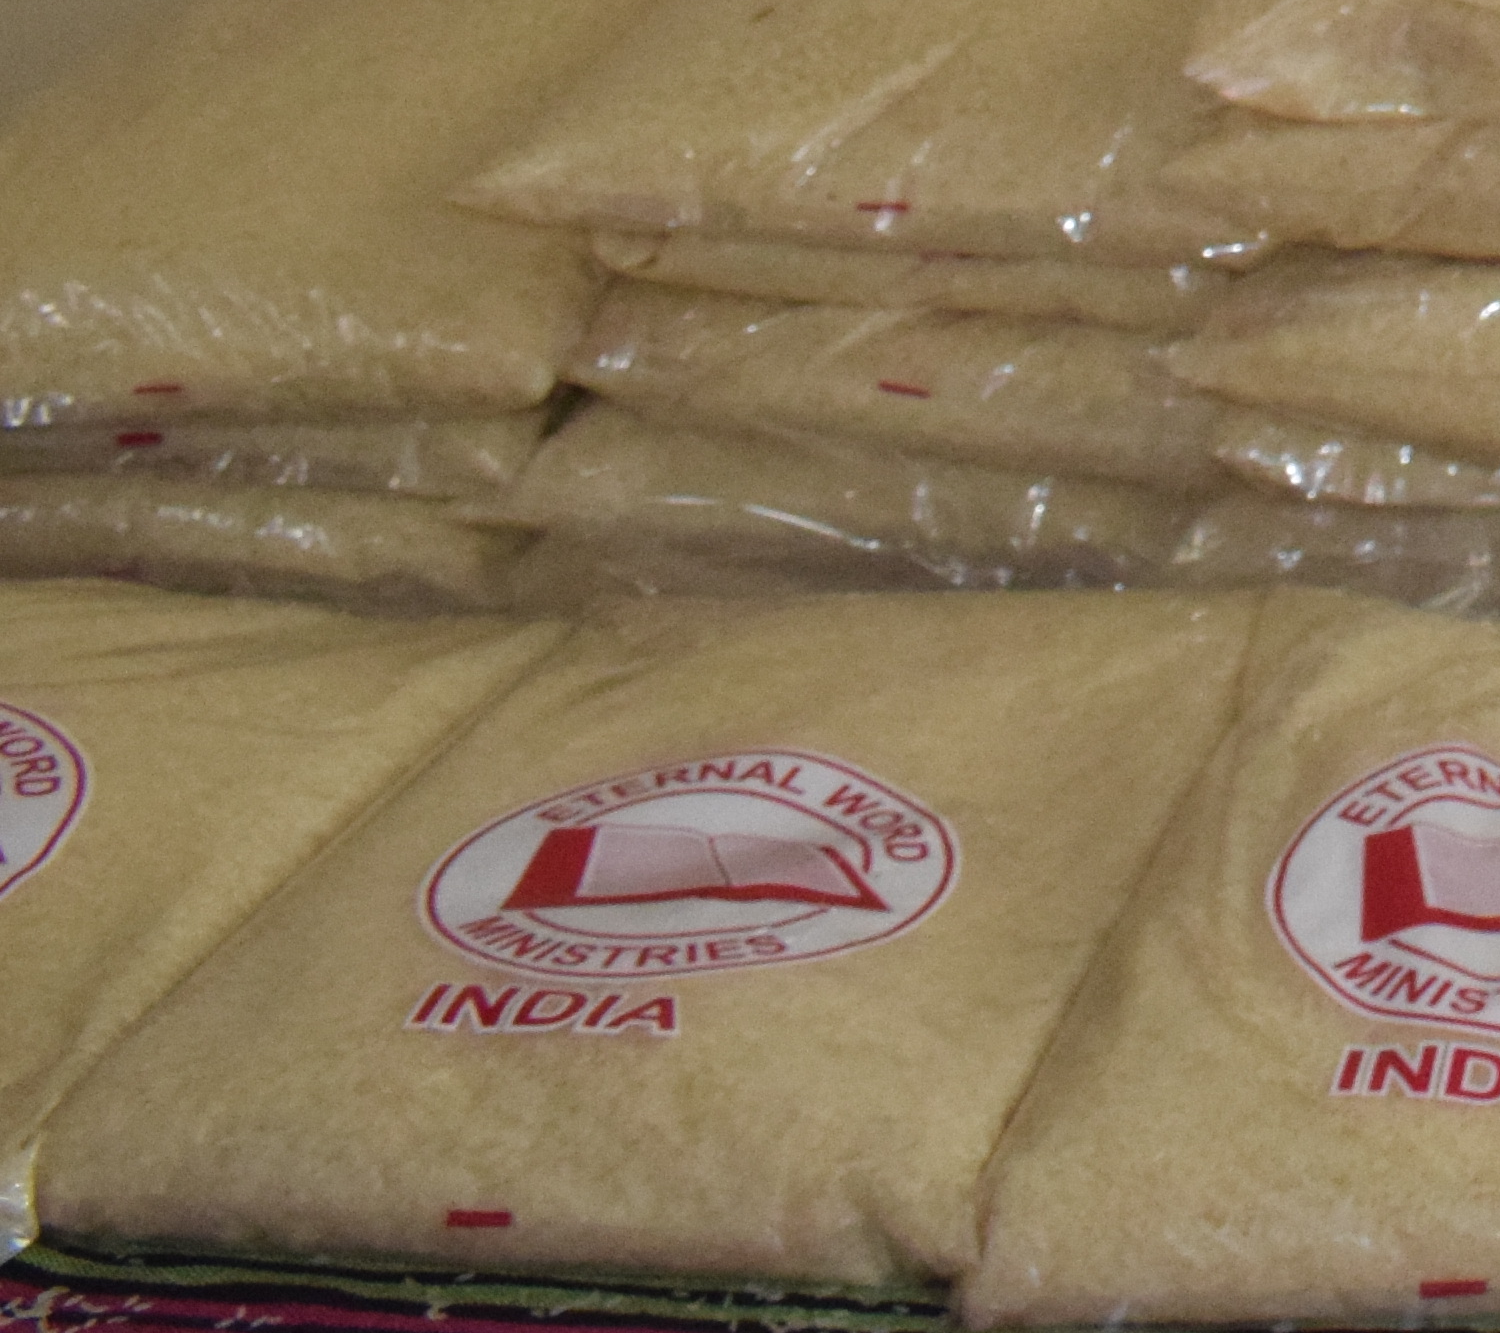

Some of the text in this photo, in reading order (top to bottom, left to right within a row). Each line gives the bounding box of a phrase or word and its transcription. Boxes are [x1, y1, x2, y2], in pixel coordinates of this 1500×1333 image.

[536, 759, 930, 864] ETERNAL WORD
[458, 916, 789, 970] MINISTRIES
[411, 983, 676, 1031] INDIA
